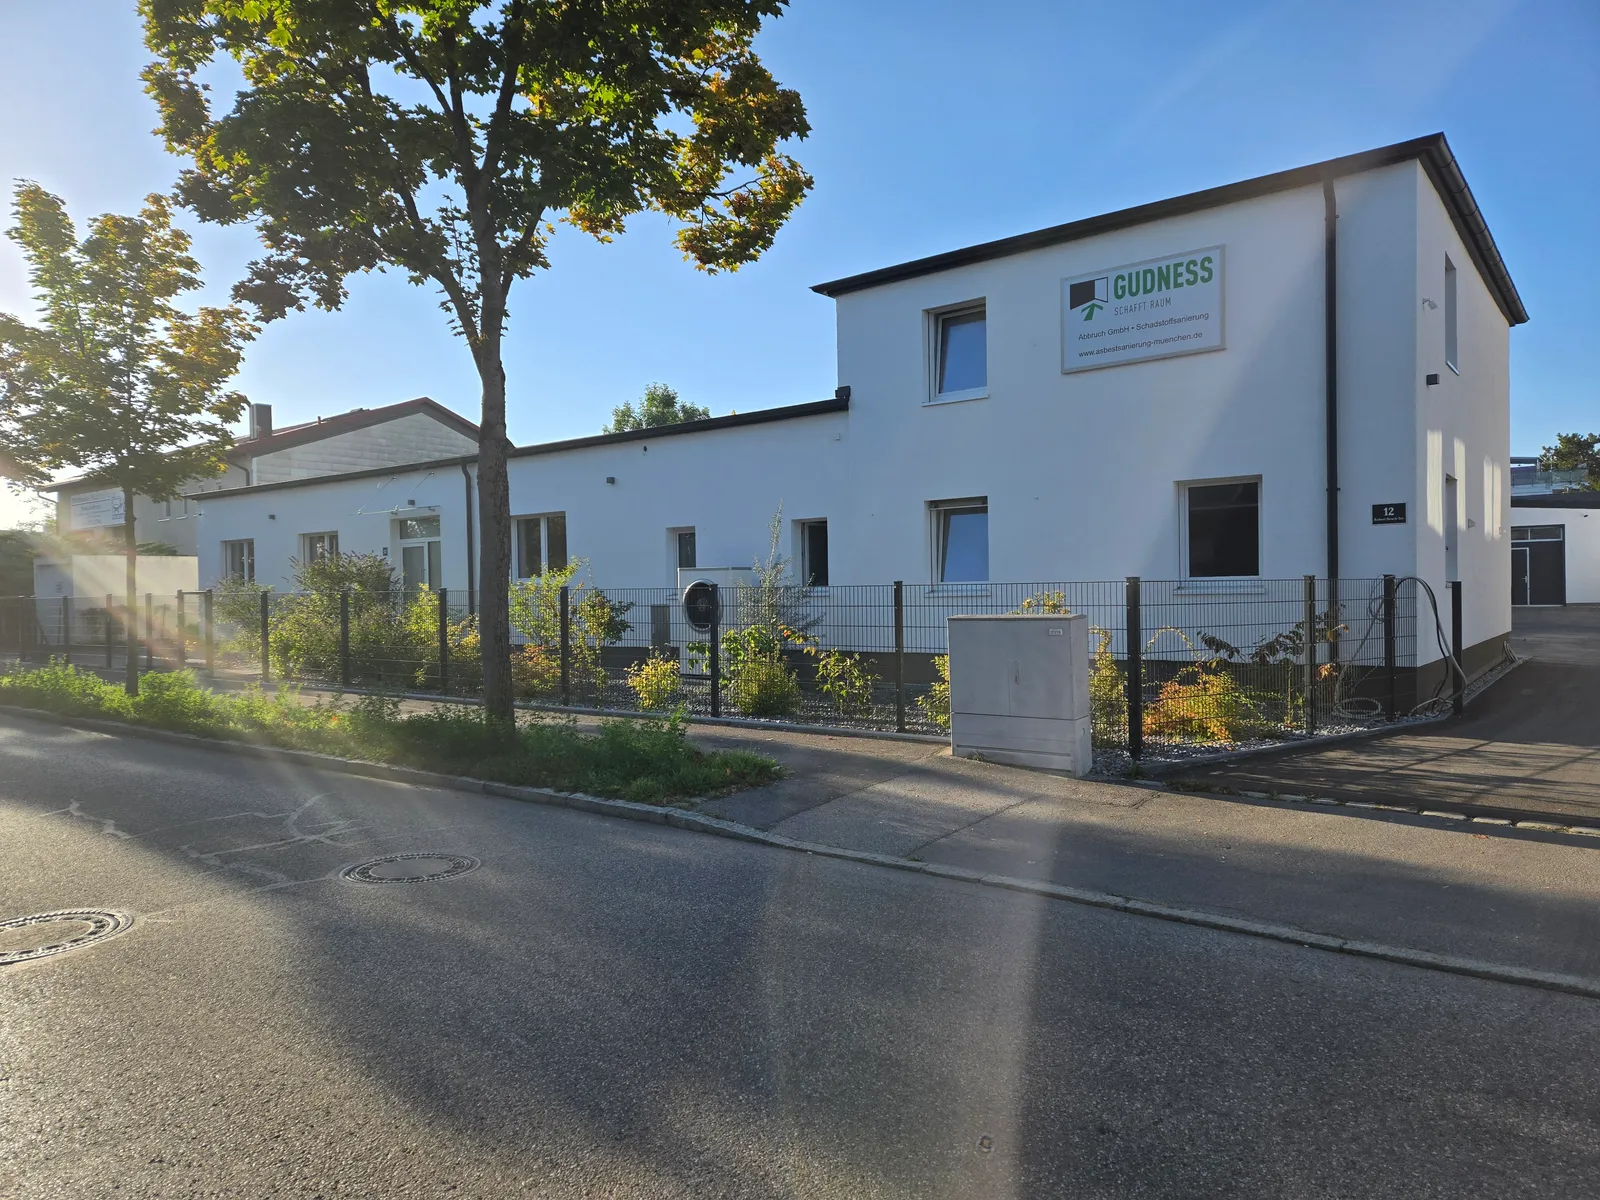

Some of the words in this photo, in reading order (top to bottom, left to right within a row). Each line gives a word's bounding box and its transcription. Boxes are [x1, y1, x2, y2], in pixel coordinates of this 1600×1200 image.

[1114, 256, 1213, 300] GUDNESS
[1114, 301, 1147, 316] SCHAFFT
[1150, 297, 1172, 309] RAUM
[1078, 331, 1106, 341] Abbruch
[1107, 325, 1130, 336] GmbH
[1135, 312, 1210, 332] Schadstoffsanierung
[1078, 331, 1203, 357] www.asbestsanierung-muenchen.de
[1383, 506, 1395, 516] 12
